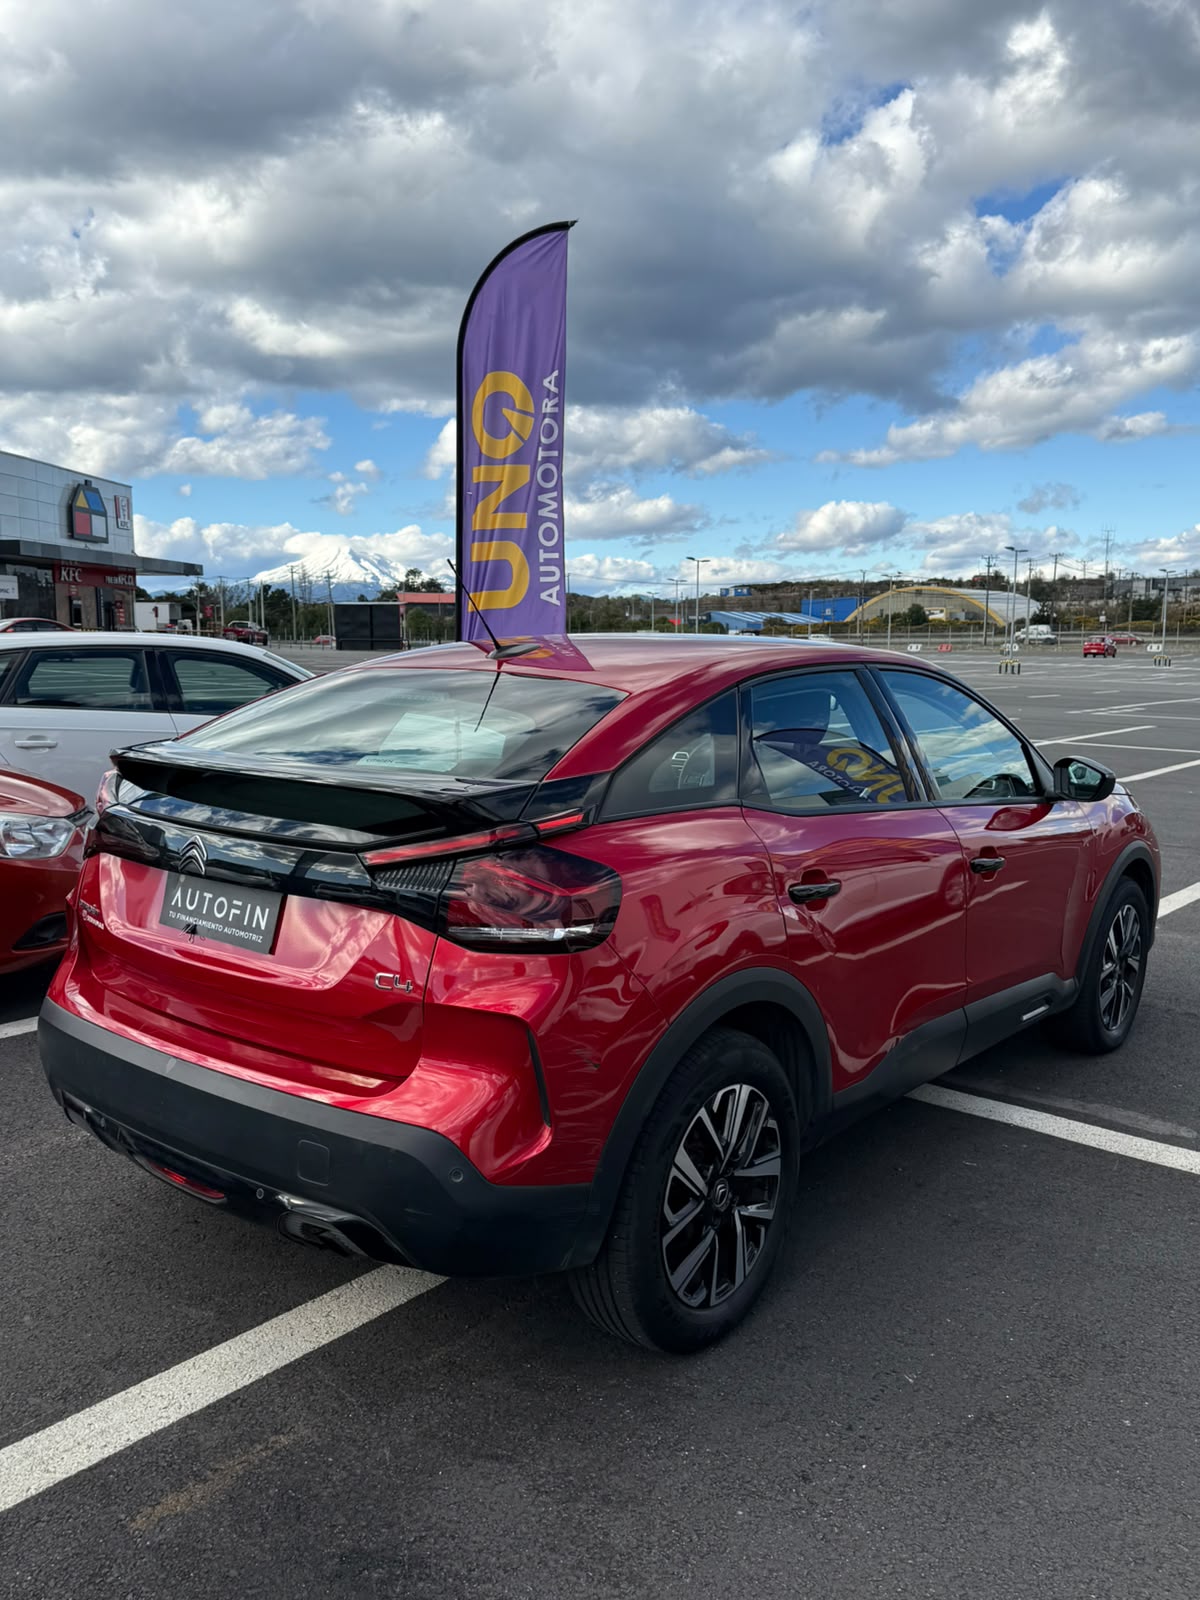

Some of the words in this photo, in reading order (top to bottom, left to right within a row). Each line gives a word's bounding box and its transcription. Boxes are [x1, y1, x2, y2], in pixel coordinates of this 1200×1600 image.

[467, 371, 535, 613] UNO
[536, 369, 560, 606] AUTOMOTORA
[61, 567, 82, 583] KFC
[168, 911, 176, 919] TU
[176, 913, 223, 932] FINANCIAMIENTO
[223, 927, 263, 943] AUTOMOTRIZ
[171, 887, 270, 930] AUTOFIN
[375, 973, 413, 992] C4
